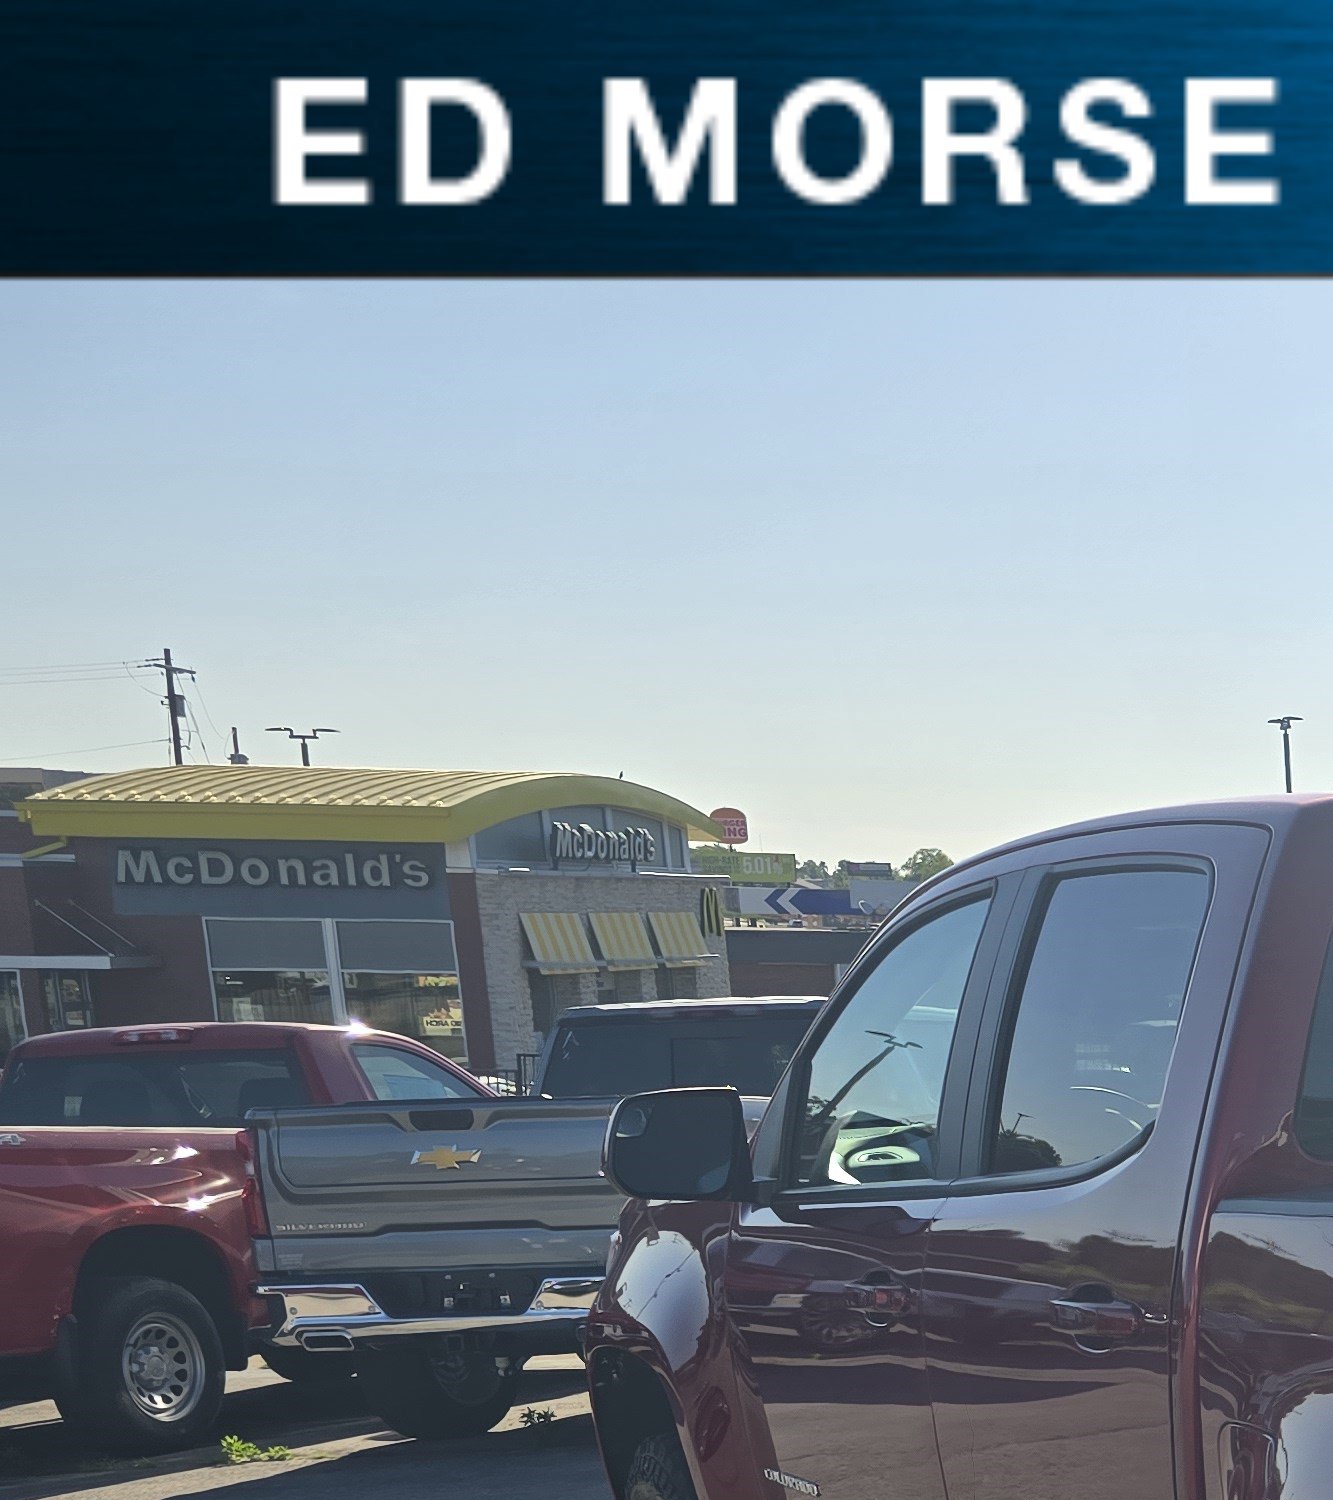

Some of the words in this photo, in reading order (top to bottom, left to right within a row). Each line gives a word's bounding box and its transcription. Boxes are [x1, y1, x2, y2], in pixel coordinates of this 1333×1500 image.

[552, 821, 657, 861] McDonald's
[723, 828, 747, 837] ING
[116, 848, 430, 889] McDonald's
